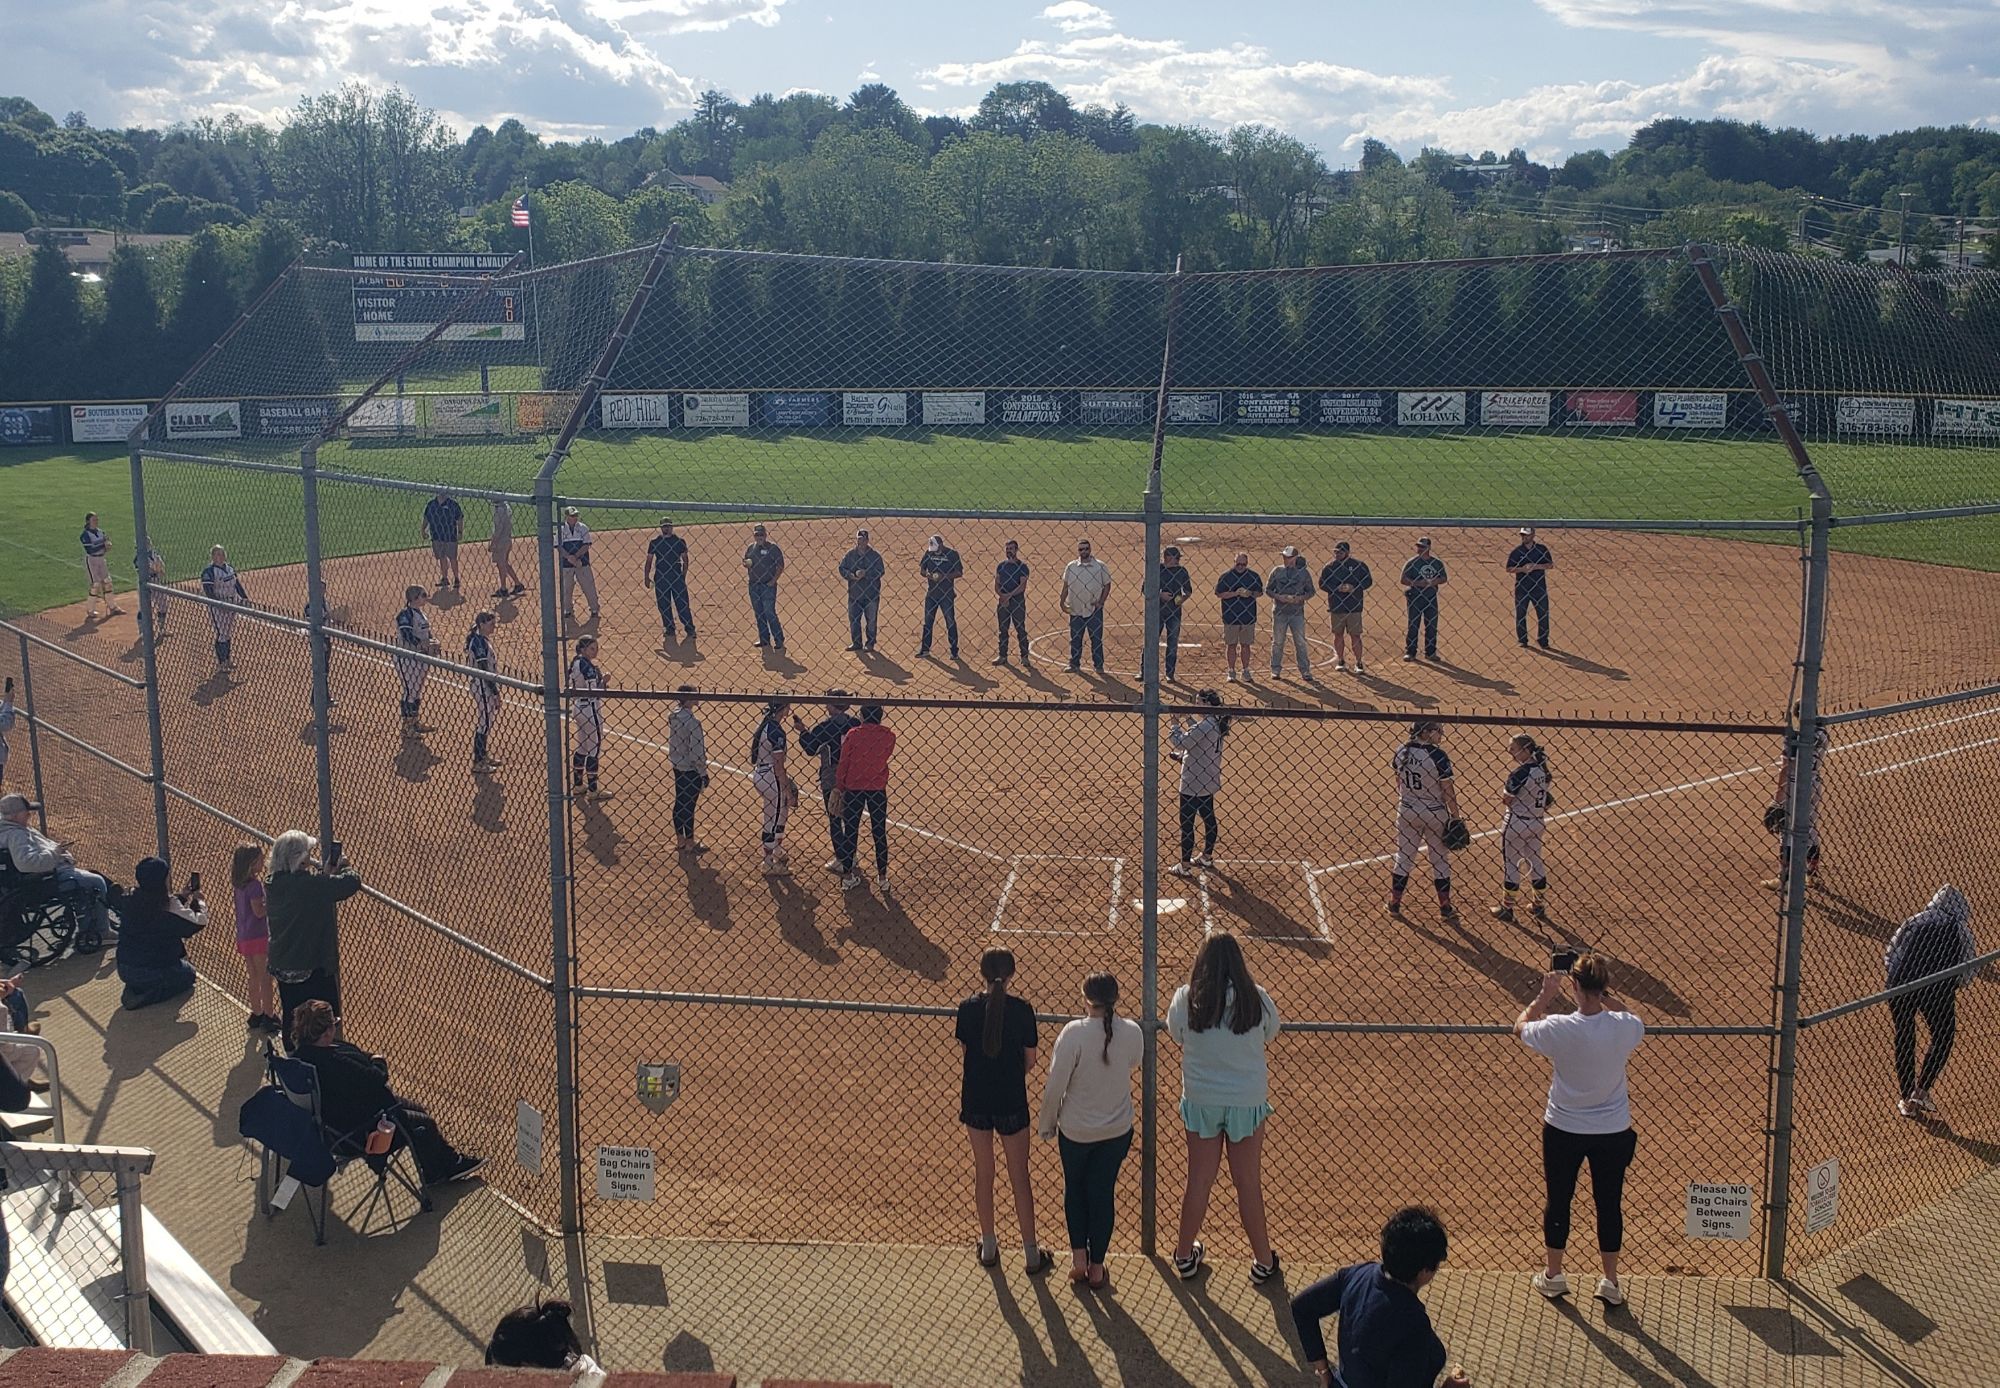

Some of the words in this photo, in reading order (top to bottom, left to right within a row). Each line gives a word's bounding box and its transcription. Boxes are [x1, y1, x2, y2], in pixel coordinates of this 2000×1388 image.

[354, 256, 377, 268] HOME
[379, 256, 389, 268] OF
[390, 256, 406, 268] THE
[407, 256, 431, 268] STATE
[432, 256, 475, 268] CHAMPION
[357, 298, 396, 308] VISITOR
[363, 311, 394, 321] HOME
[121, 407, 144, 416] STATES
[610, 397, 632, 422] RED
[636, 396, 661, 422] HILL
[1002, 402, 1050, 411] CONFERENCE
[1052, 402, 1062, 411] 24
[1247, 405, 1290, 413] CHAMPS
[1323, 407, 1369, 415] CONFERENCE
[1369, 407, 1379, 415] 24
[260, 408, 302, 417] BASEBALL
[1002, 411, 1061, 423] CHAMPIONS
[1402, 412, 1461, 422] MOHAWK
[170, 415, 211, 426] CLARK
[1325, 415, 1376, 423] CO-CHAMPIONS
[1405, 770, 1422, 790] 16
[601, 1147, 632, 1157] Please
[634, 1149, 649, 1158] NO
[599, 1158, 618, 1169] Bag
[620, 1159, 651, 1169] Chairs
[605, 1169, 646, 1180] Between
[1692, 1184, 1727, 1194] Please
[1730, 1186, 1747, 1195] NO
[1690, 1196, 1711, 1207] Bag
[1713, 1196, 1748, 1207] Chairs
[1696, 1207, 1741, 1218] Between
[1701, 1219, 1735, 1230] Signs.
[1702, 1230, 1720, 1238] Thank
[1721, 1231, 1734, 1239] You
